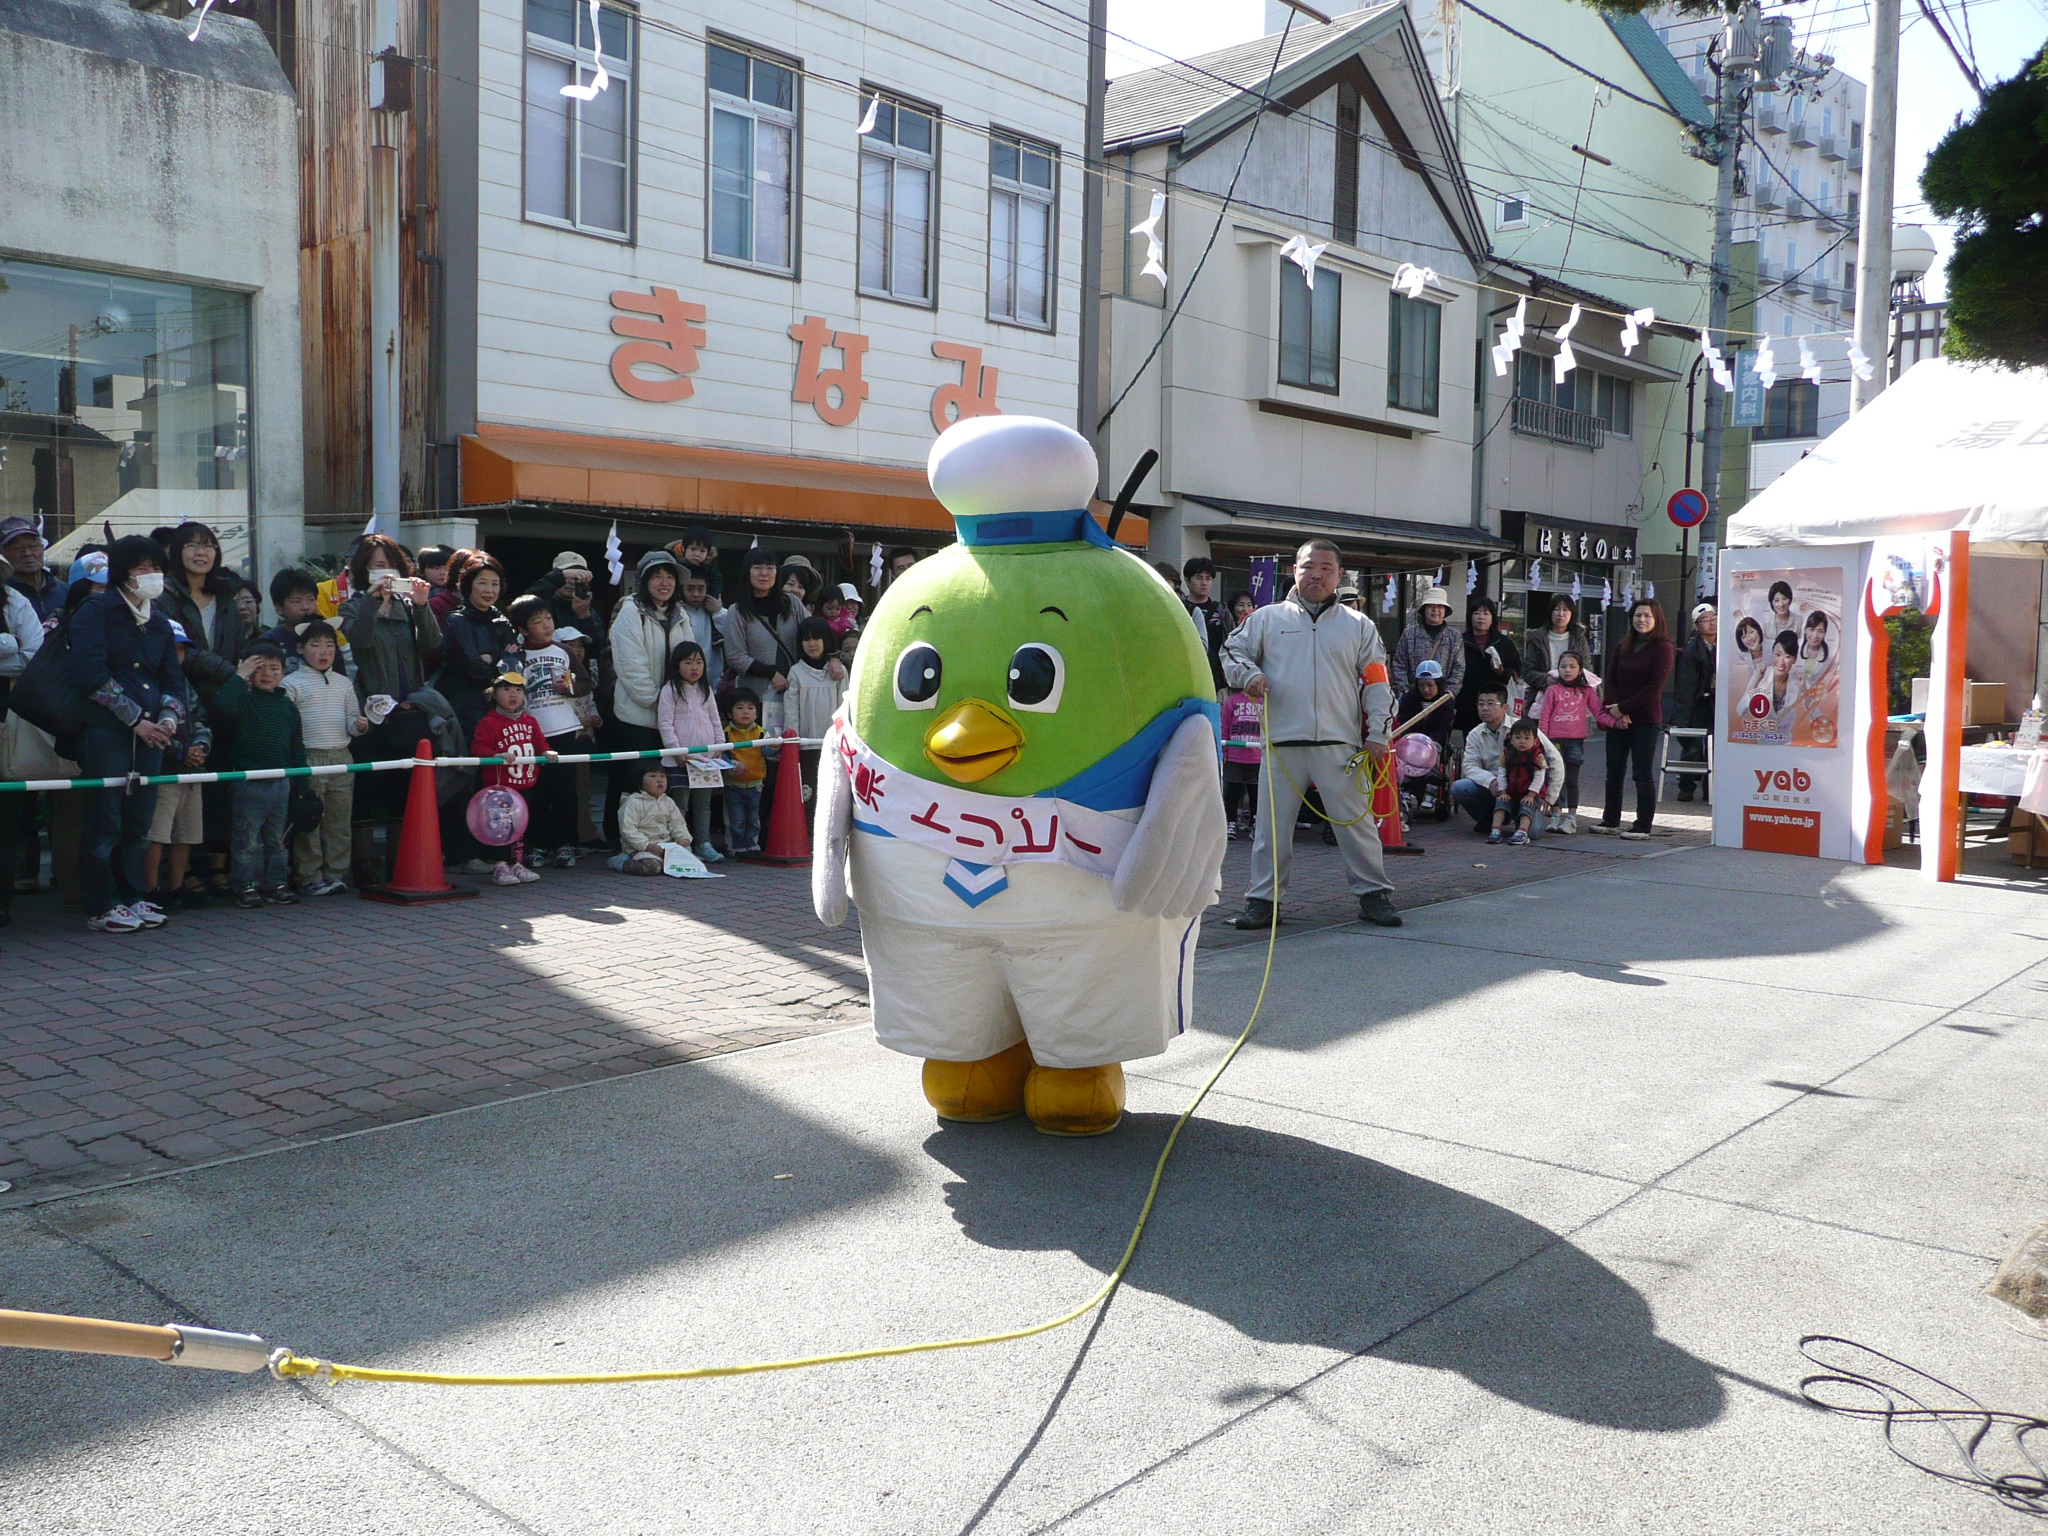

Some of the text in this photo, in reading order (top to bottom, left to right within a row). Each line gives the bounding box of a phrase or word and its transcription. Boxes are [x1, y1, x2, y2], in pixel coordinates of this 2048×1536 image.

[610, 285, 1001, 434] きなみ
[1754, 699, 1764, 714] J
[502, 723, 533, 736] GENIUS
[1753, 767, 1812, 793] yab
[1749, 812, 1815, 828] www.yab.co.jp
